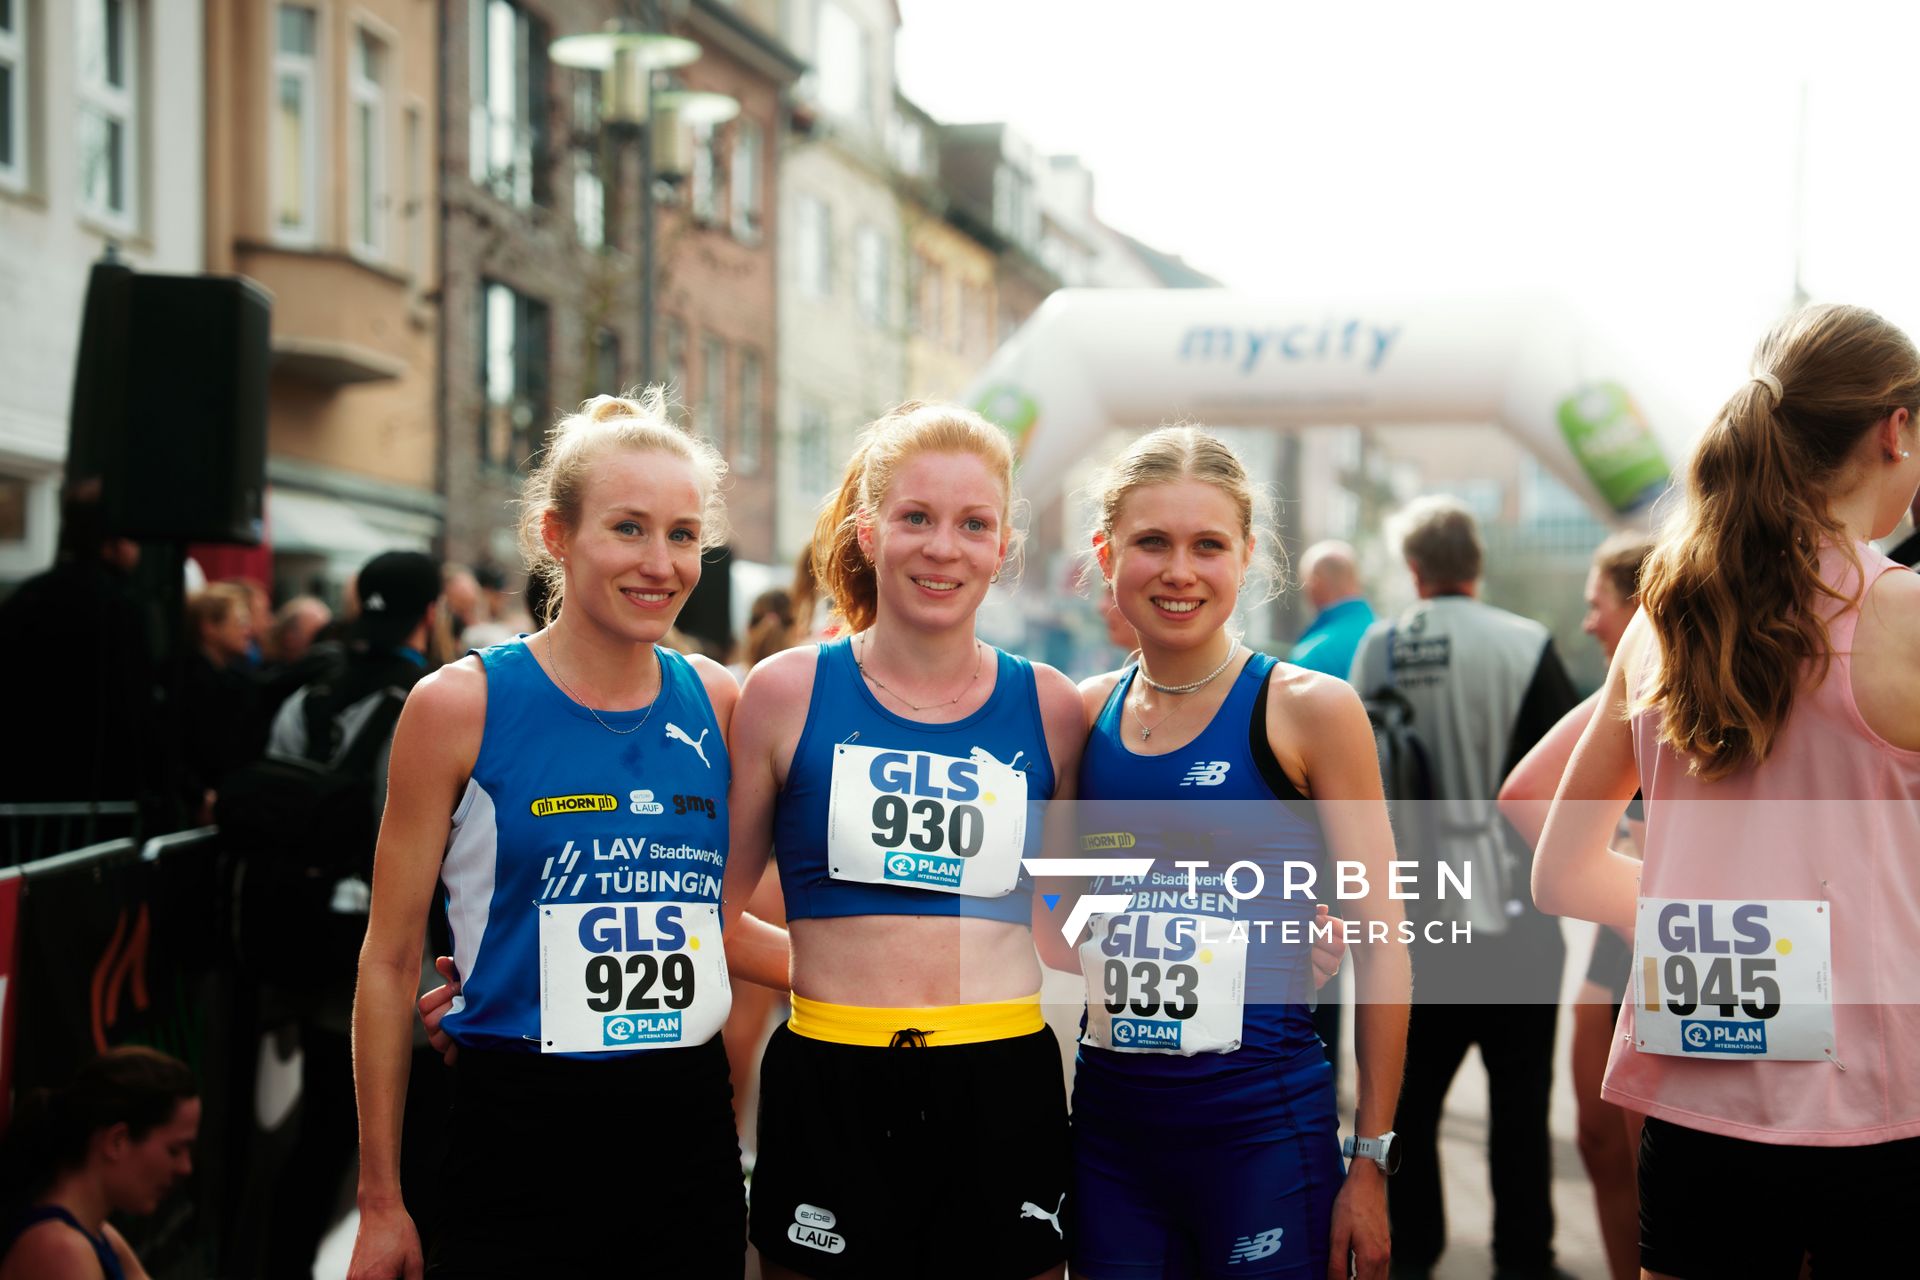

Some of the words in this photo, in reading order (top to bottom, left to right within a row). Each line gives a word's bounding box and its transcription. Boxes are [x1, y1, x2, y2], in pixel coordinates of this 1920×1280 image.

[537, 797, 553, 816] ph
[556, 798, 595, 810] HORN
[598, 794, 613, 811] ph
[635, 804, 660, 812] LAUF
[871, 795, 984, 858] 930
[593, 837, 647, 860] LAV
[650, 843, 723, 867] Stadtwerke
[917, 873, 958, 884] INTERNATIONAL
[918, 859, 962, 877] PLAN
[595, 865, 722, 900] TÜBINGEN
[1125, 888, 1238, 914] BINGEN
[585, 953, 695, 1013] 929
[1104, 959, 1199, 1020] 933
[1664, 955, 1781, 1020] 945
[637, 1018, 679, 1032] PLAN
[1138, 1025, 1178, 1040] PLAN
[1714, 1027, 1762, 1042] PLAN
[801, 1210, 831, 1223] erbe
[795, 1227, 839, 1249] LAUF
